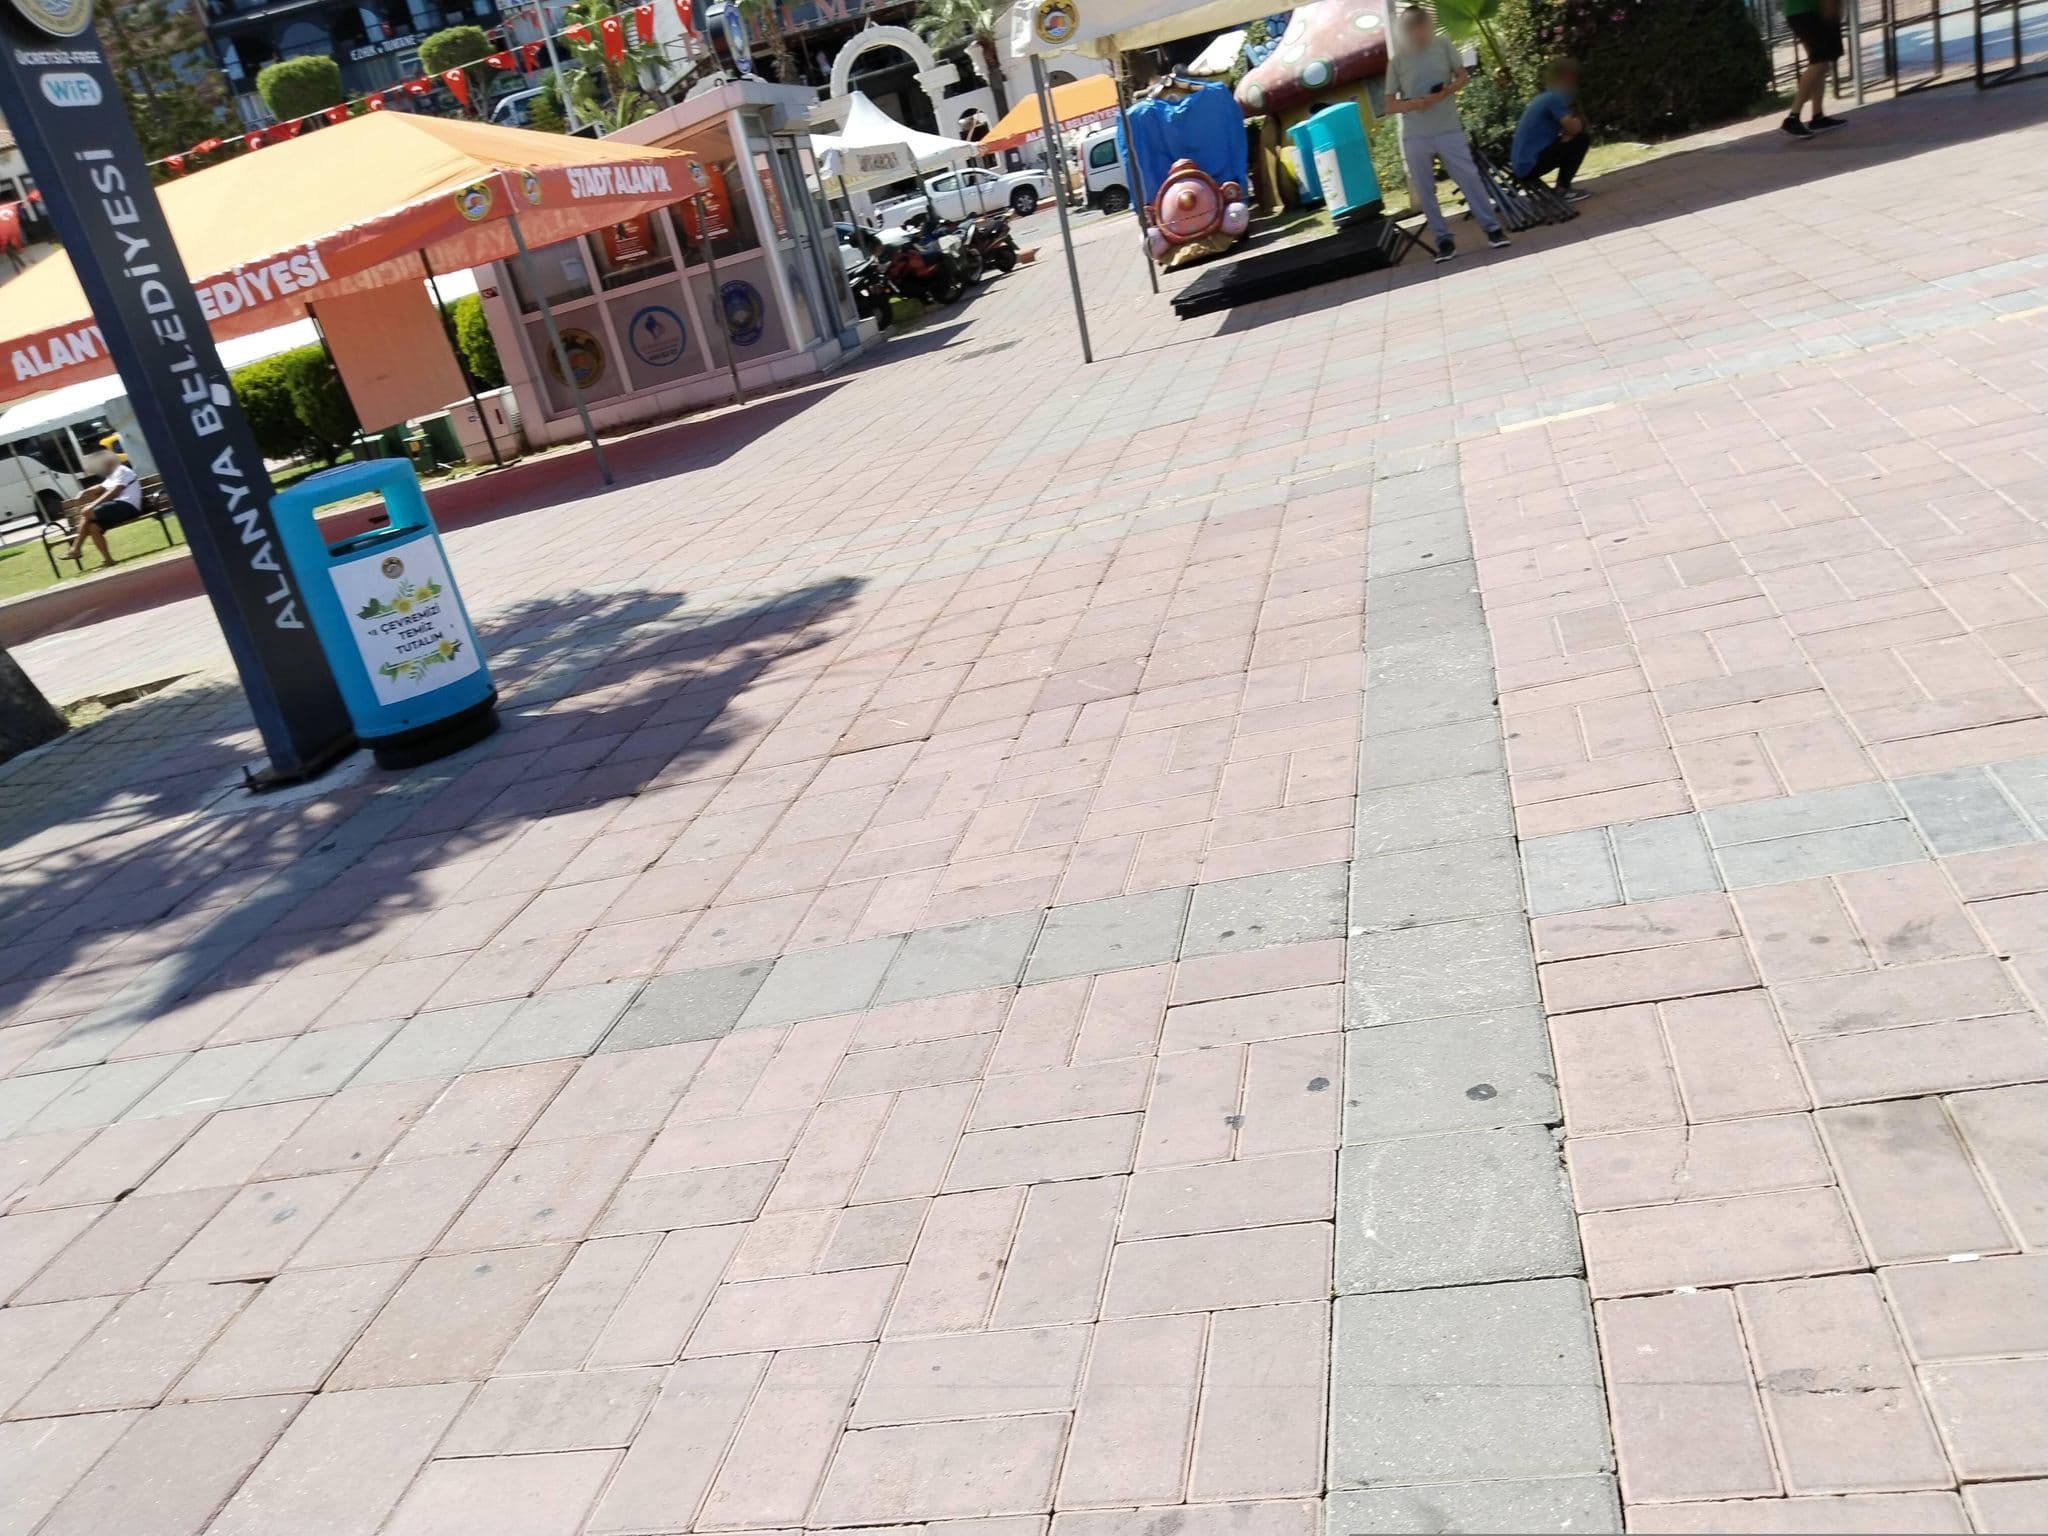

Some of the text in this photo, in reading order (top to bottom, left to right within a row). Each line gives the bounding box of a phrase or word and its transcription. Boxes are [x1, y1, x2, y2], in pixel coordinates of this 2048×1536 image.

[566, 164, 672, 199] STADT ALANYA
[11, 241, 330, 382] ALANY EDİYESİ
[75, 149, 304, 629] ALANYA BELEDİYESİ
[381, 602, 441, 635] ÇEVREMİZİ
[398, 621, 434, 640] TEMİZ
[395, 631, 444, 654] TUTALIM
